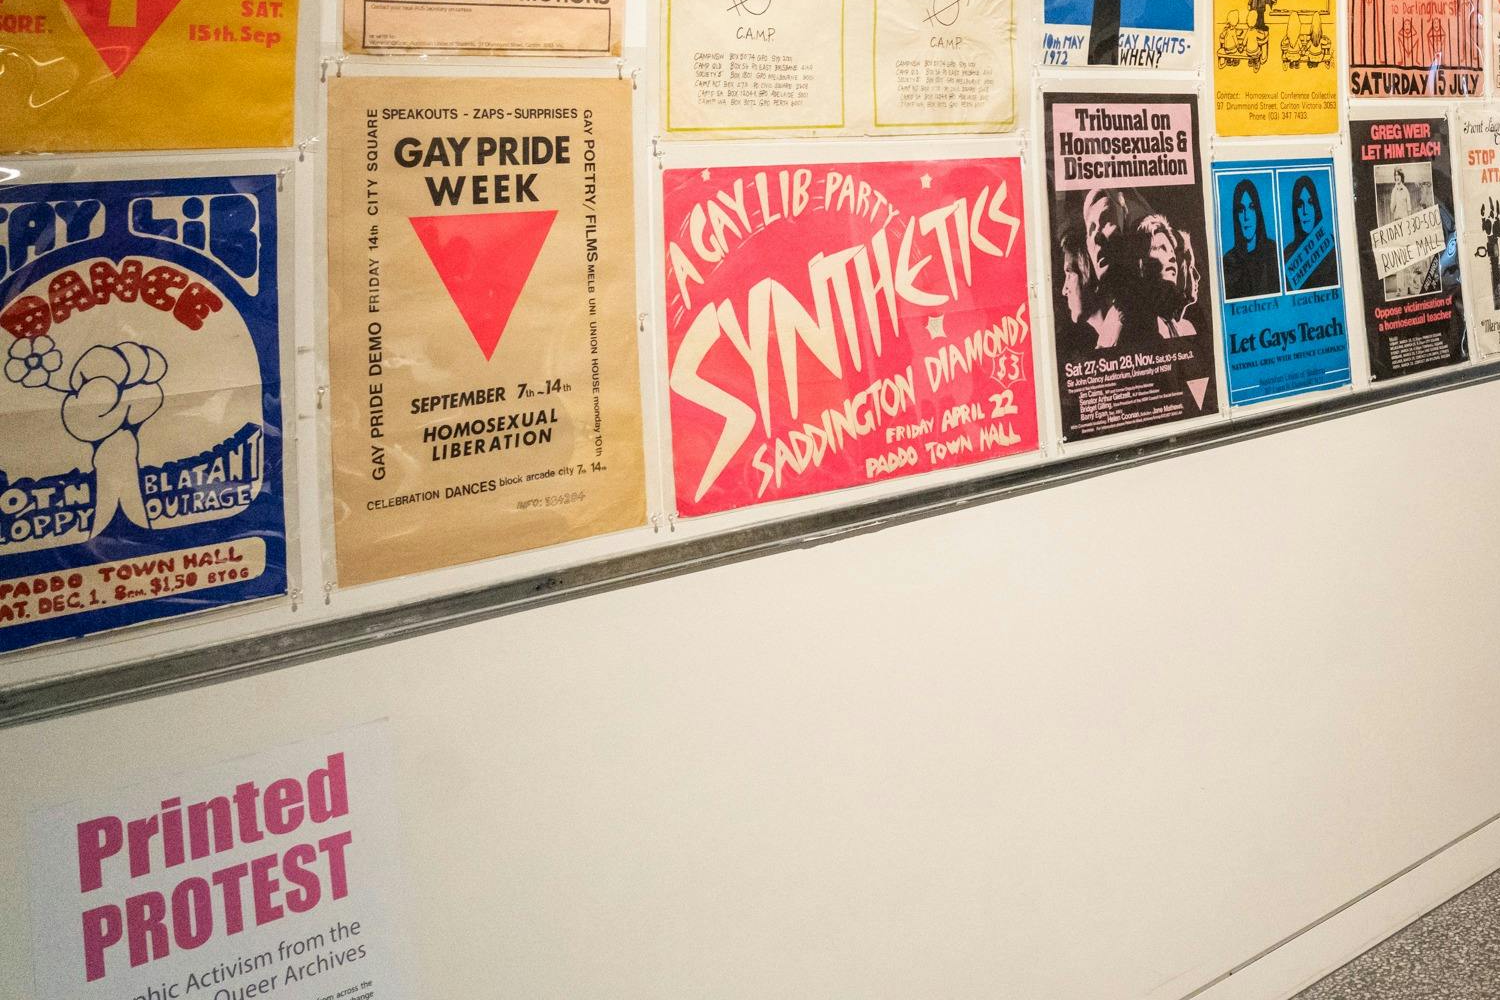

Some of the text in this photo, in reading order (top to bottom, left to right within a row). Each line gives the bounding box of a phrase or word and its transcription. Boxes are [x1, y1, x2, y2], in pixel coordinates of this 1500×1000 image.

[1351, 71, 1428, 96] SATURDAY
[1449, 73, 1479, 95] JULY
[382, 107, 458, 120] SPEAKOUTS
[1075, 108, 1171, 132] Tribunal on
[1371, 122, 1430, 139] GREG WEIR
[394, 135, 571, 168] GAY PRIDE
[1060, 131, 1187, 156] Homosexuals &
[1361, 142, 1440, 160] LET HIM TEACH
[1468, 149, 1496, 166] STOP
[1064, 155, 1188, 180] Discrimination
[424, 173, 540, 207] WEEK
[669, 168, 900, 310] A GAY LIB PARTY
[2, 260, 224, 340] DANCE
[669, 180, 1021, 504] SYNTHETICS
[1230, 317, 1343, 354] Let Gays Teach
[410, 386, 506, 414] SEPTEMBER
[752, 303, 1029, 499] SADDINGTON DIAMONDS
[423, 408, 558, 443] HOMOSEXUAL
[144, 428, 263, 493] BLATANT
[431, 428, 553, 462] LIBERATION
[146, 484, 251, 521] OUTRAGE
[366, 467, 574, 511] CELEBRATION DANCES block arcade city
[76, 751, 349, 893] Printed
[82, 830, 352, 982] PROTEST
[185, 920, 361, 994] Activism from the
[213, 944, 367, 1000] Queer Archives
